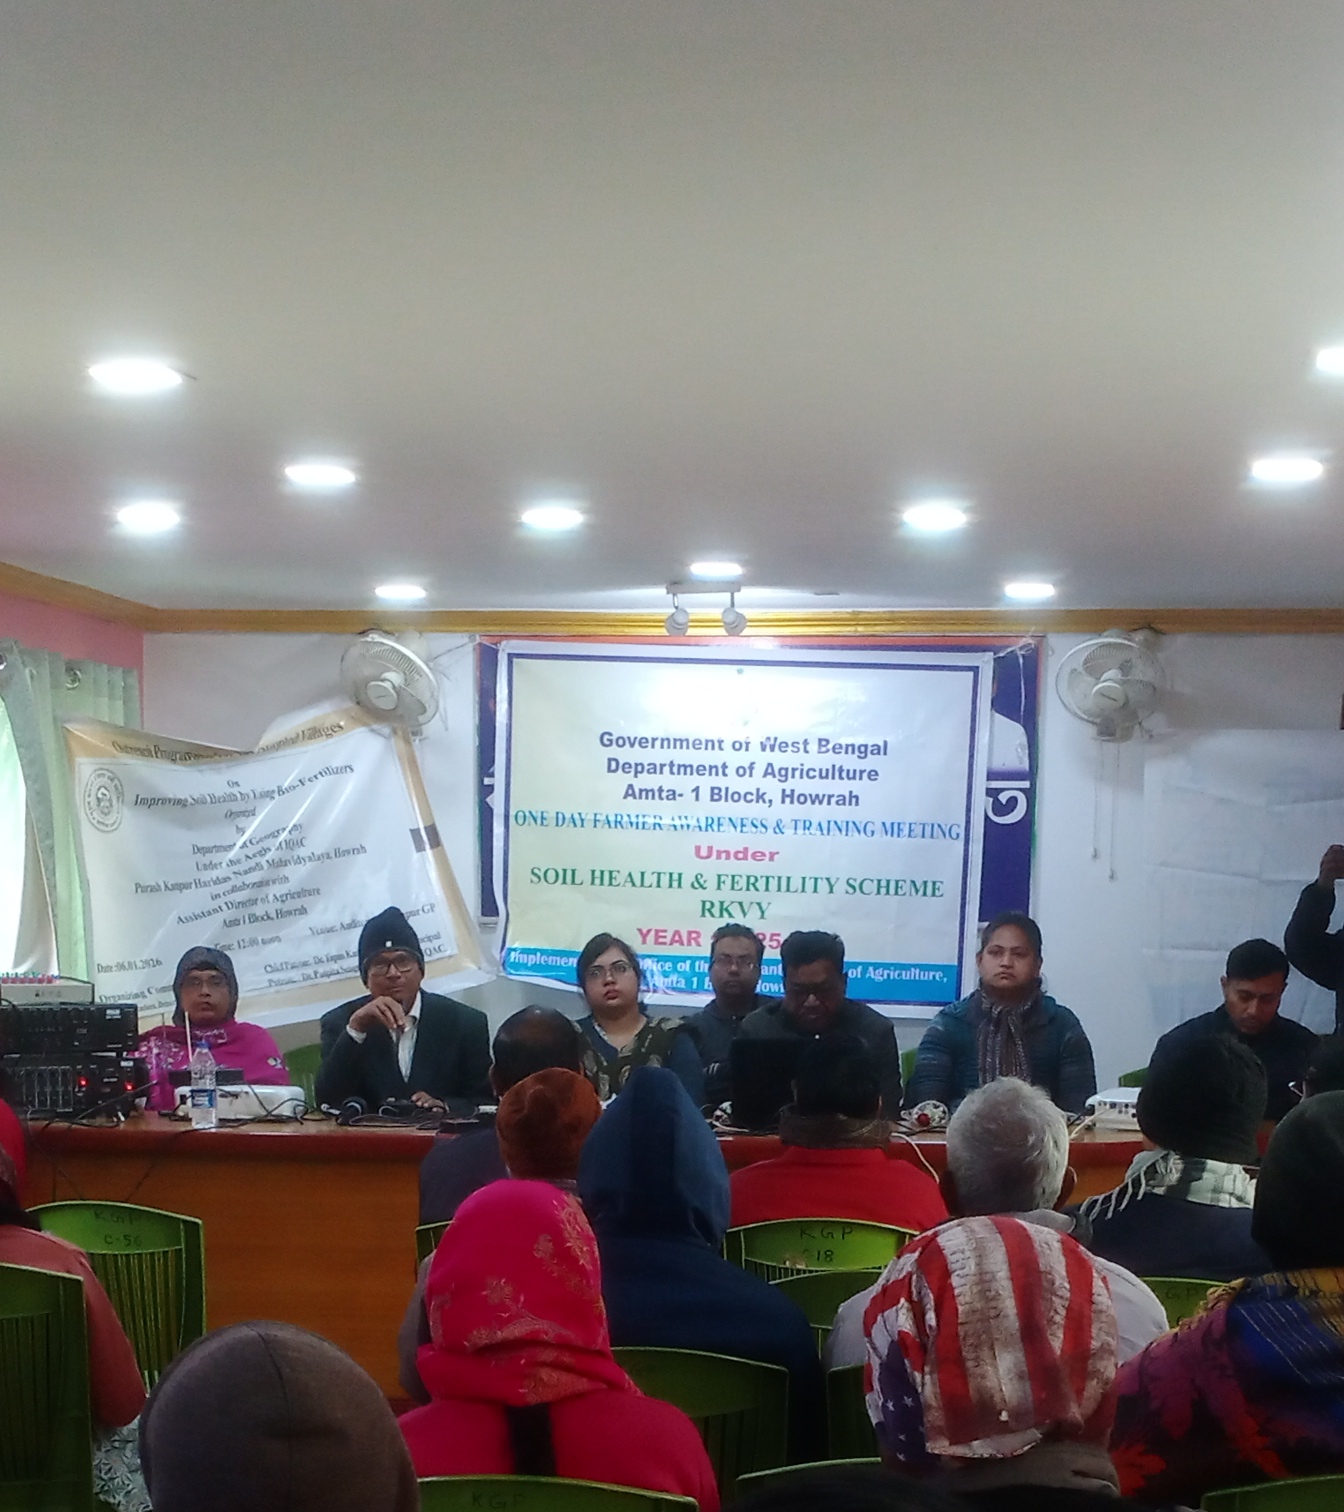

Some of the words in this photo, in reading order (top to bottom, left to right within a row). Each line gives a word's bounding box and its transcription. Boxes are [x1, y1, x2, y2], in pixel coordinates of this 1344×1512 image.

[599, 731, 724, 751] Government
[759, 736, 810, 754] West
[817, 737, 889, 760] Bengal
[606, 757, 728, 778] Department
[735, 761, 756, 778] of
[762, 761, 880, 783] Agriculture
[134, 793, 189, 809] Improving
[690, 785, 701, 802] 1
[709, 786, 773, 808] Block,
[780, 788, 860, 807] Howrah
[514, 809, 550, 828] ONE
[554, 811, 587, 829] DAY
[592, 812, 665, 832] FARMER
[665, 814, 769, 835] AWARENESS
[773, 818, 786, 836] &
[790, 818, 876, 839] TRAINING
[880, 820, 961, 841] MEETING
[694, 845, 780, 862] Under
[193, 875, 232, 890] Haridas
[529, 866, 584, 886] SOIL
[589, 869, 683, 890] HEALTH
[690, 873, 709, 891] &
[714, 873, 841, 895] FERTILITY
[845, 877, 945, 898] SCHEME
[699, 899, 772, 920] RKVY
[635, 927, 703, 948] YEAR
[676, 958, 692, 973] of
[847, 965, 863, 979] of
[865, 965, 948, 983] Agriculture,
